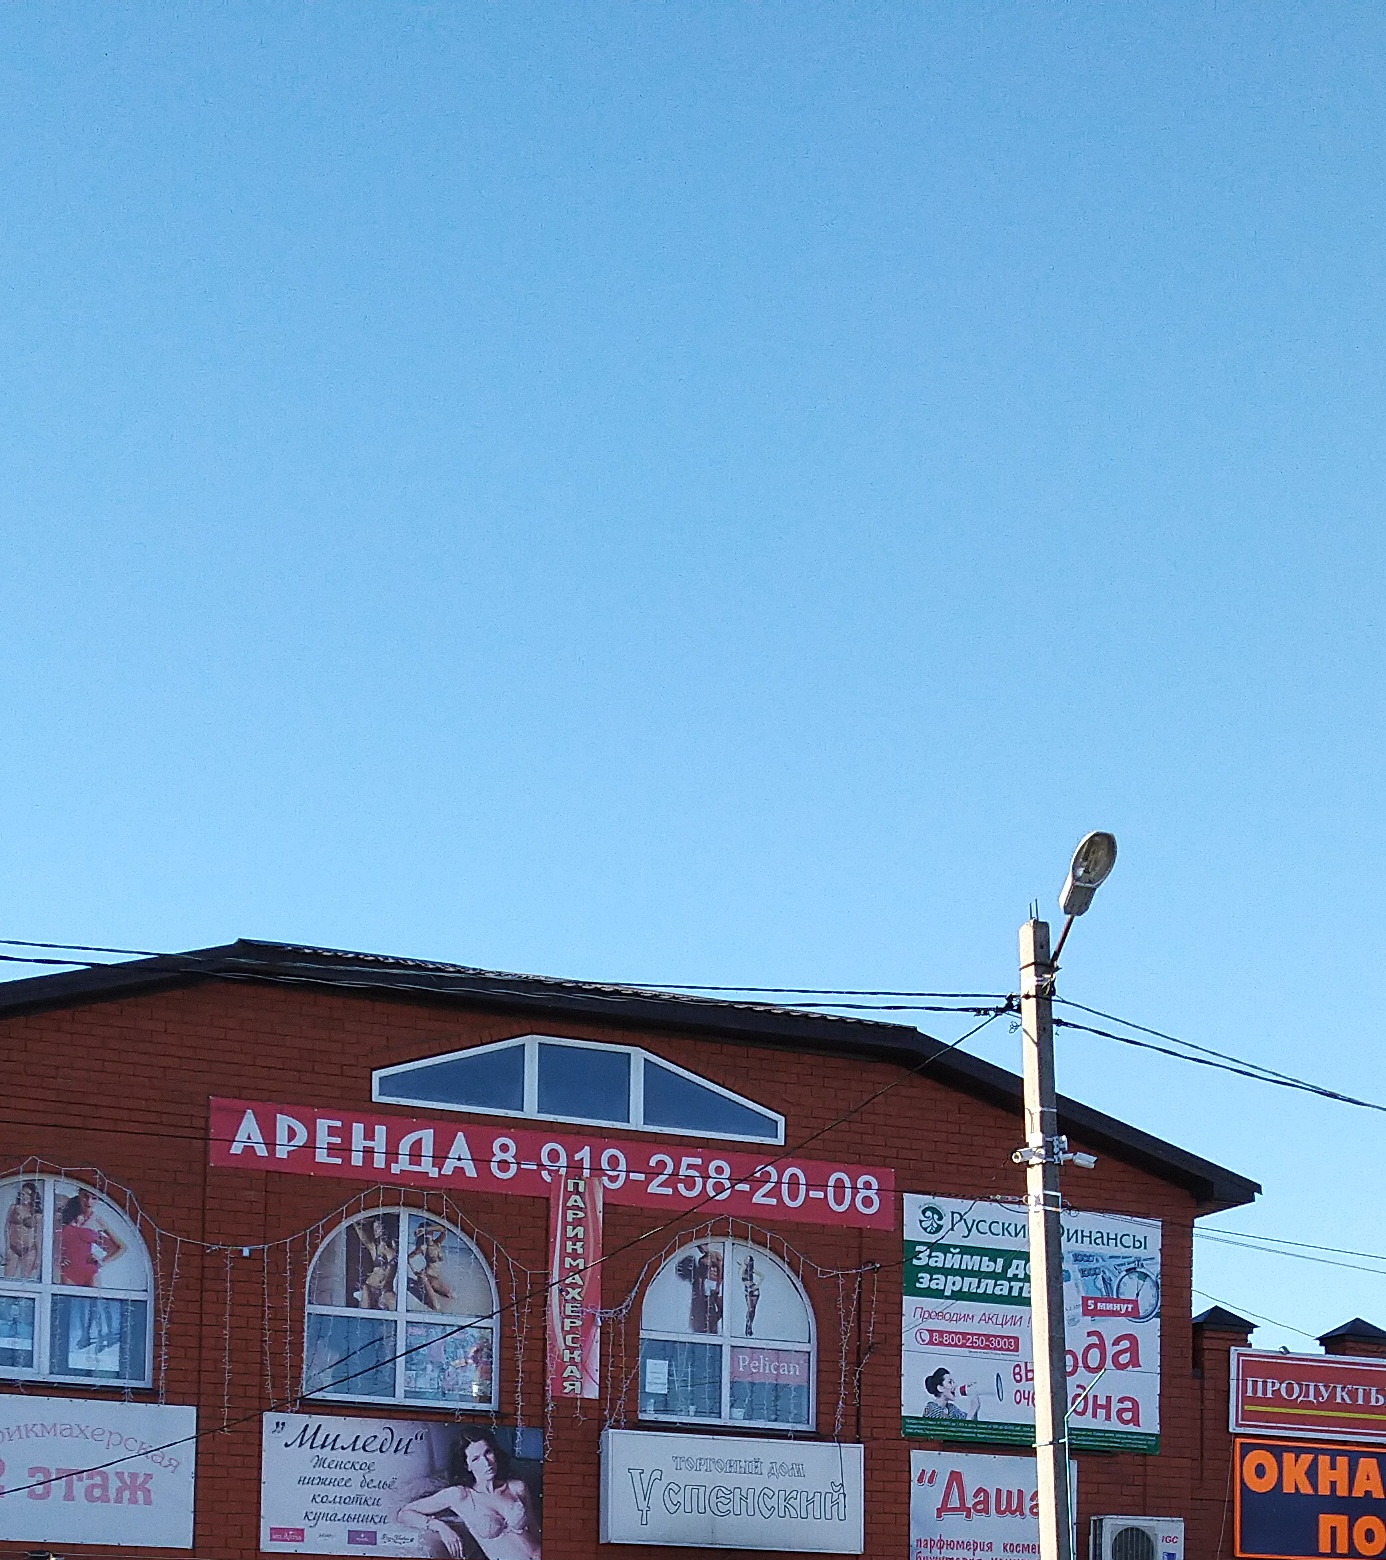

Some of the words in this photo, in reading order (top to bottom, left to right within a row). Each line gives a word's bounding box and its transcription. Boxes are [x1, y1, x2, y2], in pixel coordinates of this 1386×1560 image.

[229, 1110, 478, 1178] АРЕНДА
[491, 1137, 881, 1215] 8-919-258-20-08
[950, 1211, 1029, 1239] Русски
[1062, 1225, 1148, 1251] инансы
[912, 1246, 1004, 1273] Займы
[562, 1179, 585, 1394] ПАРИКМАХЕРСКАЯ
[913, 1306, 974, 1324] Проводим
[978, 1312, 1023, 1328] АКЦИИ
[1087, 1299, 1096, 1310] 5
[1097, 1302, 1134, 1314] минут
[933, 1332, 1015, 1350] 8-800-250-3003
[737, 1355, 801, 1376] Pelican
[310, 1454, 376, 1473] Женское
[672, 1455, 764, 1476] ТОРГОВЫЙ
[767, 1461, 806, 1479] ДОМ
[1242, 1449, 1386, 1500] ОКНА
[26, 1466, 153, 1506] этаж
[297, 1474, 353, 1489] нижнее
[311, 1493, 383, 1507] колготки
[303, 1509, 390, 1529] купальники
[916, 1534, 993, 1556] парфюмерия
[1002, 1541, 1040, 1555] косме
